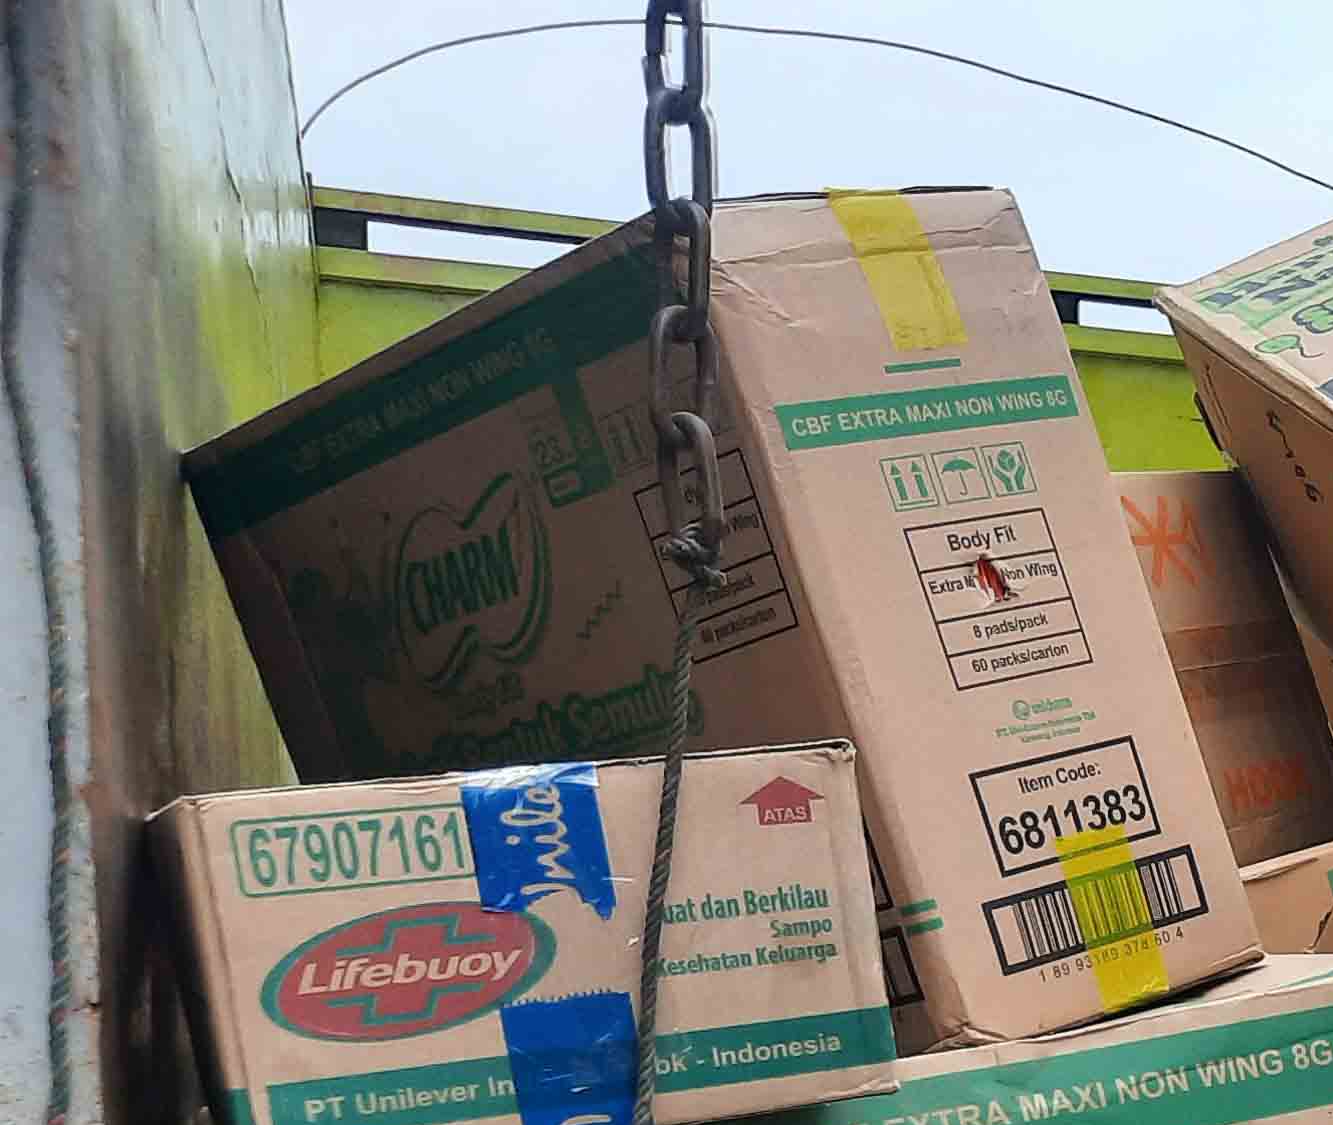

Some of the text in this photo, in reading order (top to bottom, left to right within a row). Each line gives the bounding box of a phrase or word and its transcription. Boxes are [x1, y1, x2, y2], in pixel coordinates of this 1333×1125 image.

[792, 389, 1067, 437] CBF EXTRA MAXI NON WING 8G
[947, 524, 1016, 552] Body Fit
[406, 526, 521, 636] CHARM
[928, 573, 964, 595] Extra
[1026, 560, 1058, 583] Wing
[973, 612, 1048, 639] 8 pads/pack
[972, 643, 1070, 675] 60 packs/carton
[1018, 761, 1102, 795] Item Code:
[762, 805, 808, 823] ATAS
[998, 784, 1147, 856] 6811383
[248, 813, 467, 889] 67907161
[662, 883, 829, 925] uat dan Berkilau
[769, 915, 834, 939] Sampo
[299, 945, 523, 997] Lifebuoy
[653, 941, 838, 978] Kesehatan Keluarga
[1052, 962, 1071, 980] 89
[1175, 926, 1184, 940] 4
[303, 1096, 345, 1125] PT
[353, 1080, 480, 1117] Unilever
[711, 1030, 842, 1070] Indonesia
[1019, 1081, 1108, 1123] MAXI
[1117, 1065, 1190, 1105] NON
[1196, 1047, 1285, 1090] WING
